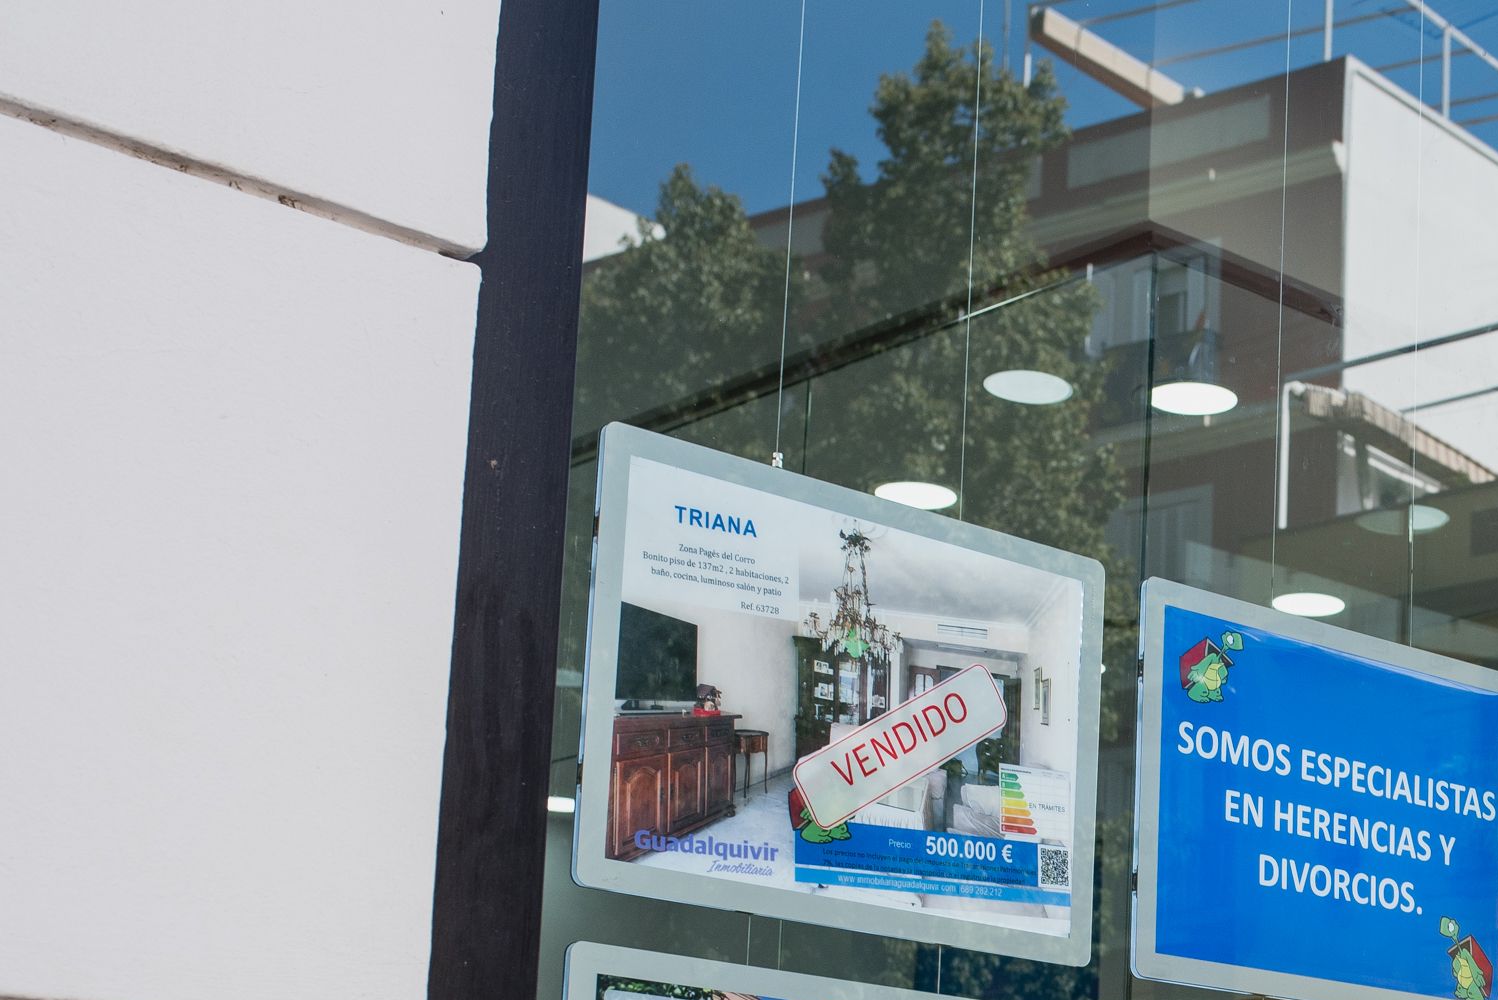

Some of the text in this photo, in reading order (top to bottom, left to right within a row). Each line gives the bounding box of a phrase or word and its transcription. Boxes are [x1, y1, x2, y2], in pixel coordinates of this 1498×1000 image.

[675, 505, 757, 538] TRIANA
[643, 550, 668, 563] Bonito
[670, 557, 685, 568] piso
[687, 558, 697, 568] de
[729, 566, 734, 575] 2
[736, 567, 783, 584] habitaciones,
[784, 576, 790, 585] 2
[679, 543, 697, 555] Zona
[722, 551, 733, 561] del
[735, 554, 756, 565] Corro
[651, 566, 782, 596] baño, cocina, luminoso salón y patio
[741, 601, 780, 615] Ref. 63728
[831, 692, 968, 787] VENDIDO
[1177, 721, 1496, 822] SOMOS ESPECIALISTAS
[1225, 789, 1456, 866] EN HERENCIAS Y
[634, 829, 779, 862] Guadalquivir
[926, 836, 996, 862] 500.000
[1001, 844, 1013, 864] €
[706, 860, 774, 877] Inmobiliaria
[1258, 853, 1423, 916] DIVORCIOS.
